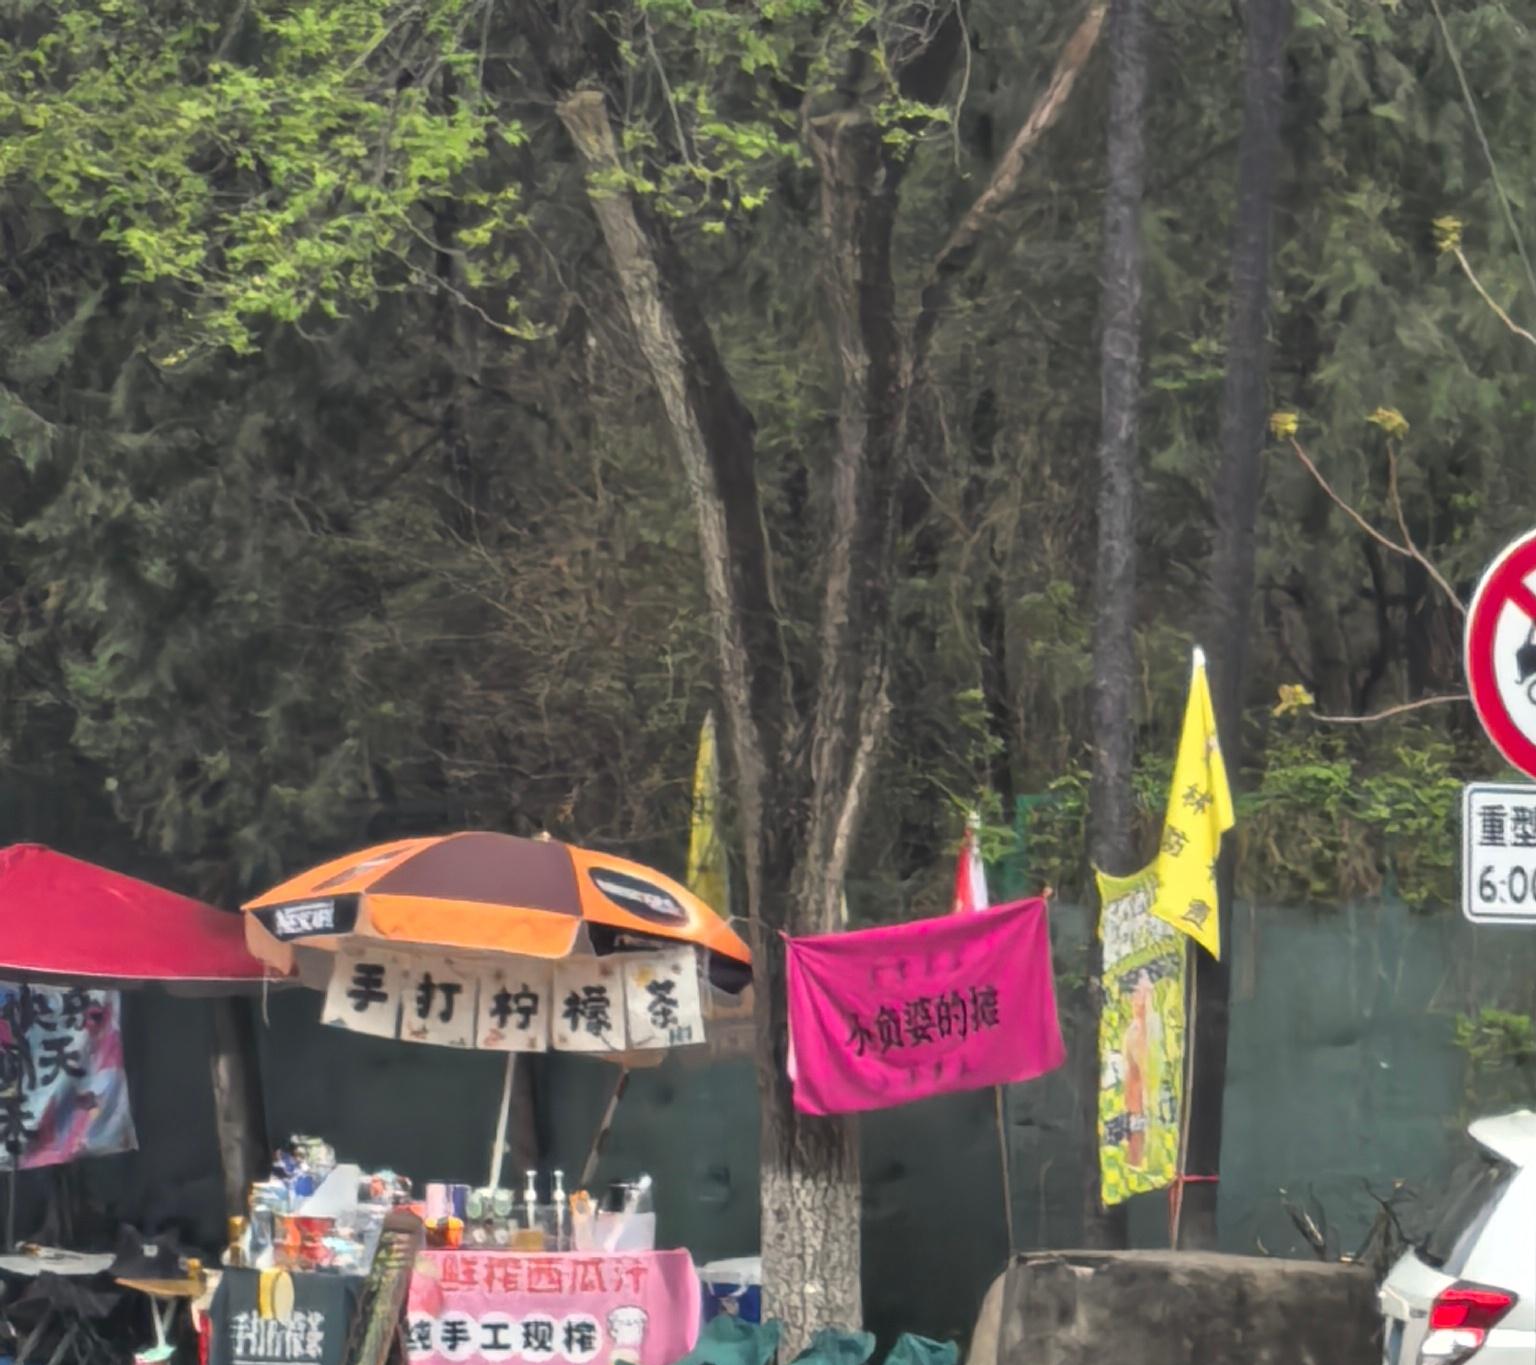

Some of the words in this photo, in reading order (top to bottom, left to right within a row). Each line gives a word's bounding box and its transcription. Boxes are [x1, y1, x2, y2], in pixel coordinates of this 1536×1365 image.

[347, 963, 678, 1038] 手打柠檬茶
[440, 1256, 648, 1294] 鲜榨西瓜汁
[407, 1319, 598, 1352] 纯手工现榨
